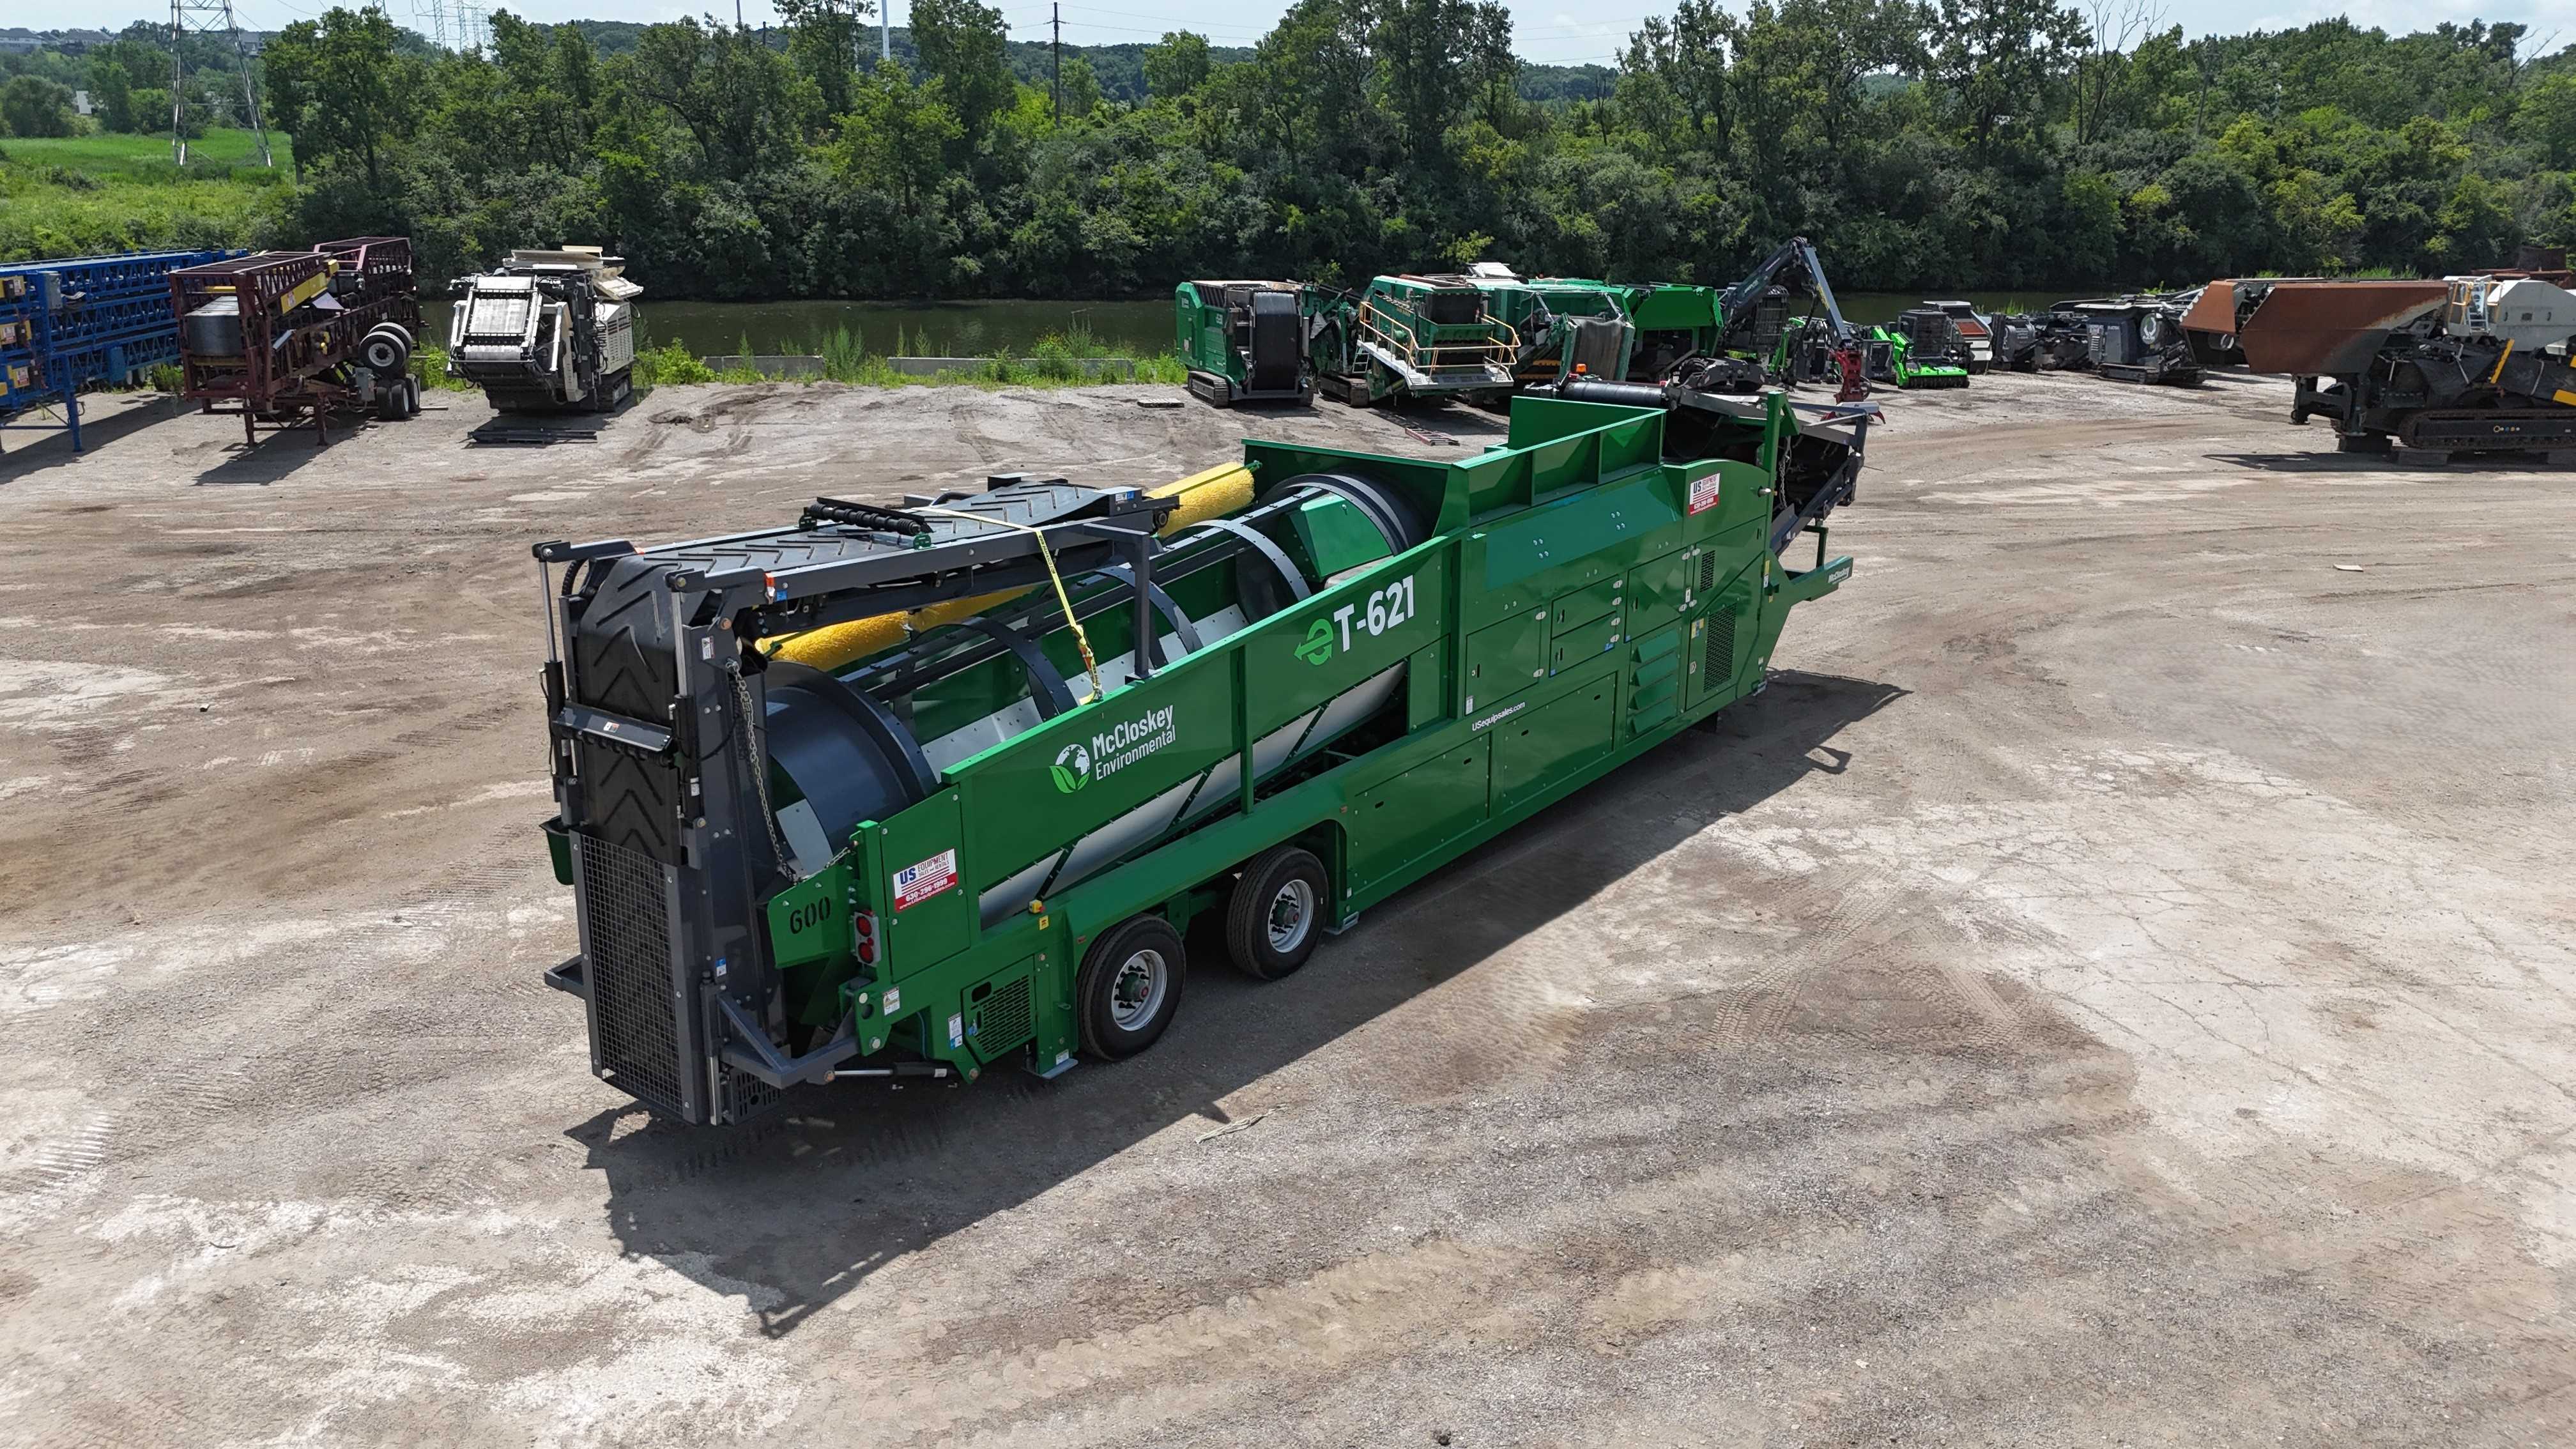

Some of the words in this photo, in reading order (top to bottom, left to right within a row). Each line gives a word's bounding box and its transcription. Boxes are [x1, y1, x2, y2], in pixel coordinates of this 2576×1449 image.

[1694, 481, 1701, 494] US
[1472, 702, 1525, 731] USequipsales.com
[1092, 705, 1173, 760] McCloskey
[1095, 724, 1176, 781] Environmental
[900, 867, 916, 885] US
[917, 852, 948, 872] EQUIPMENT
[790, 896, 831, 935] 600
